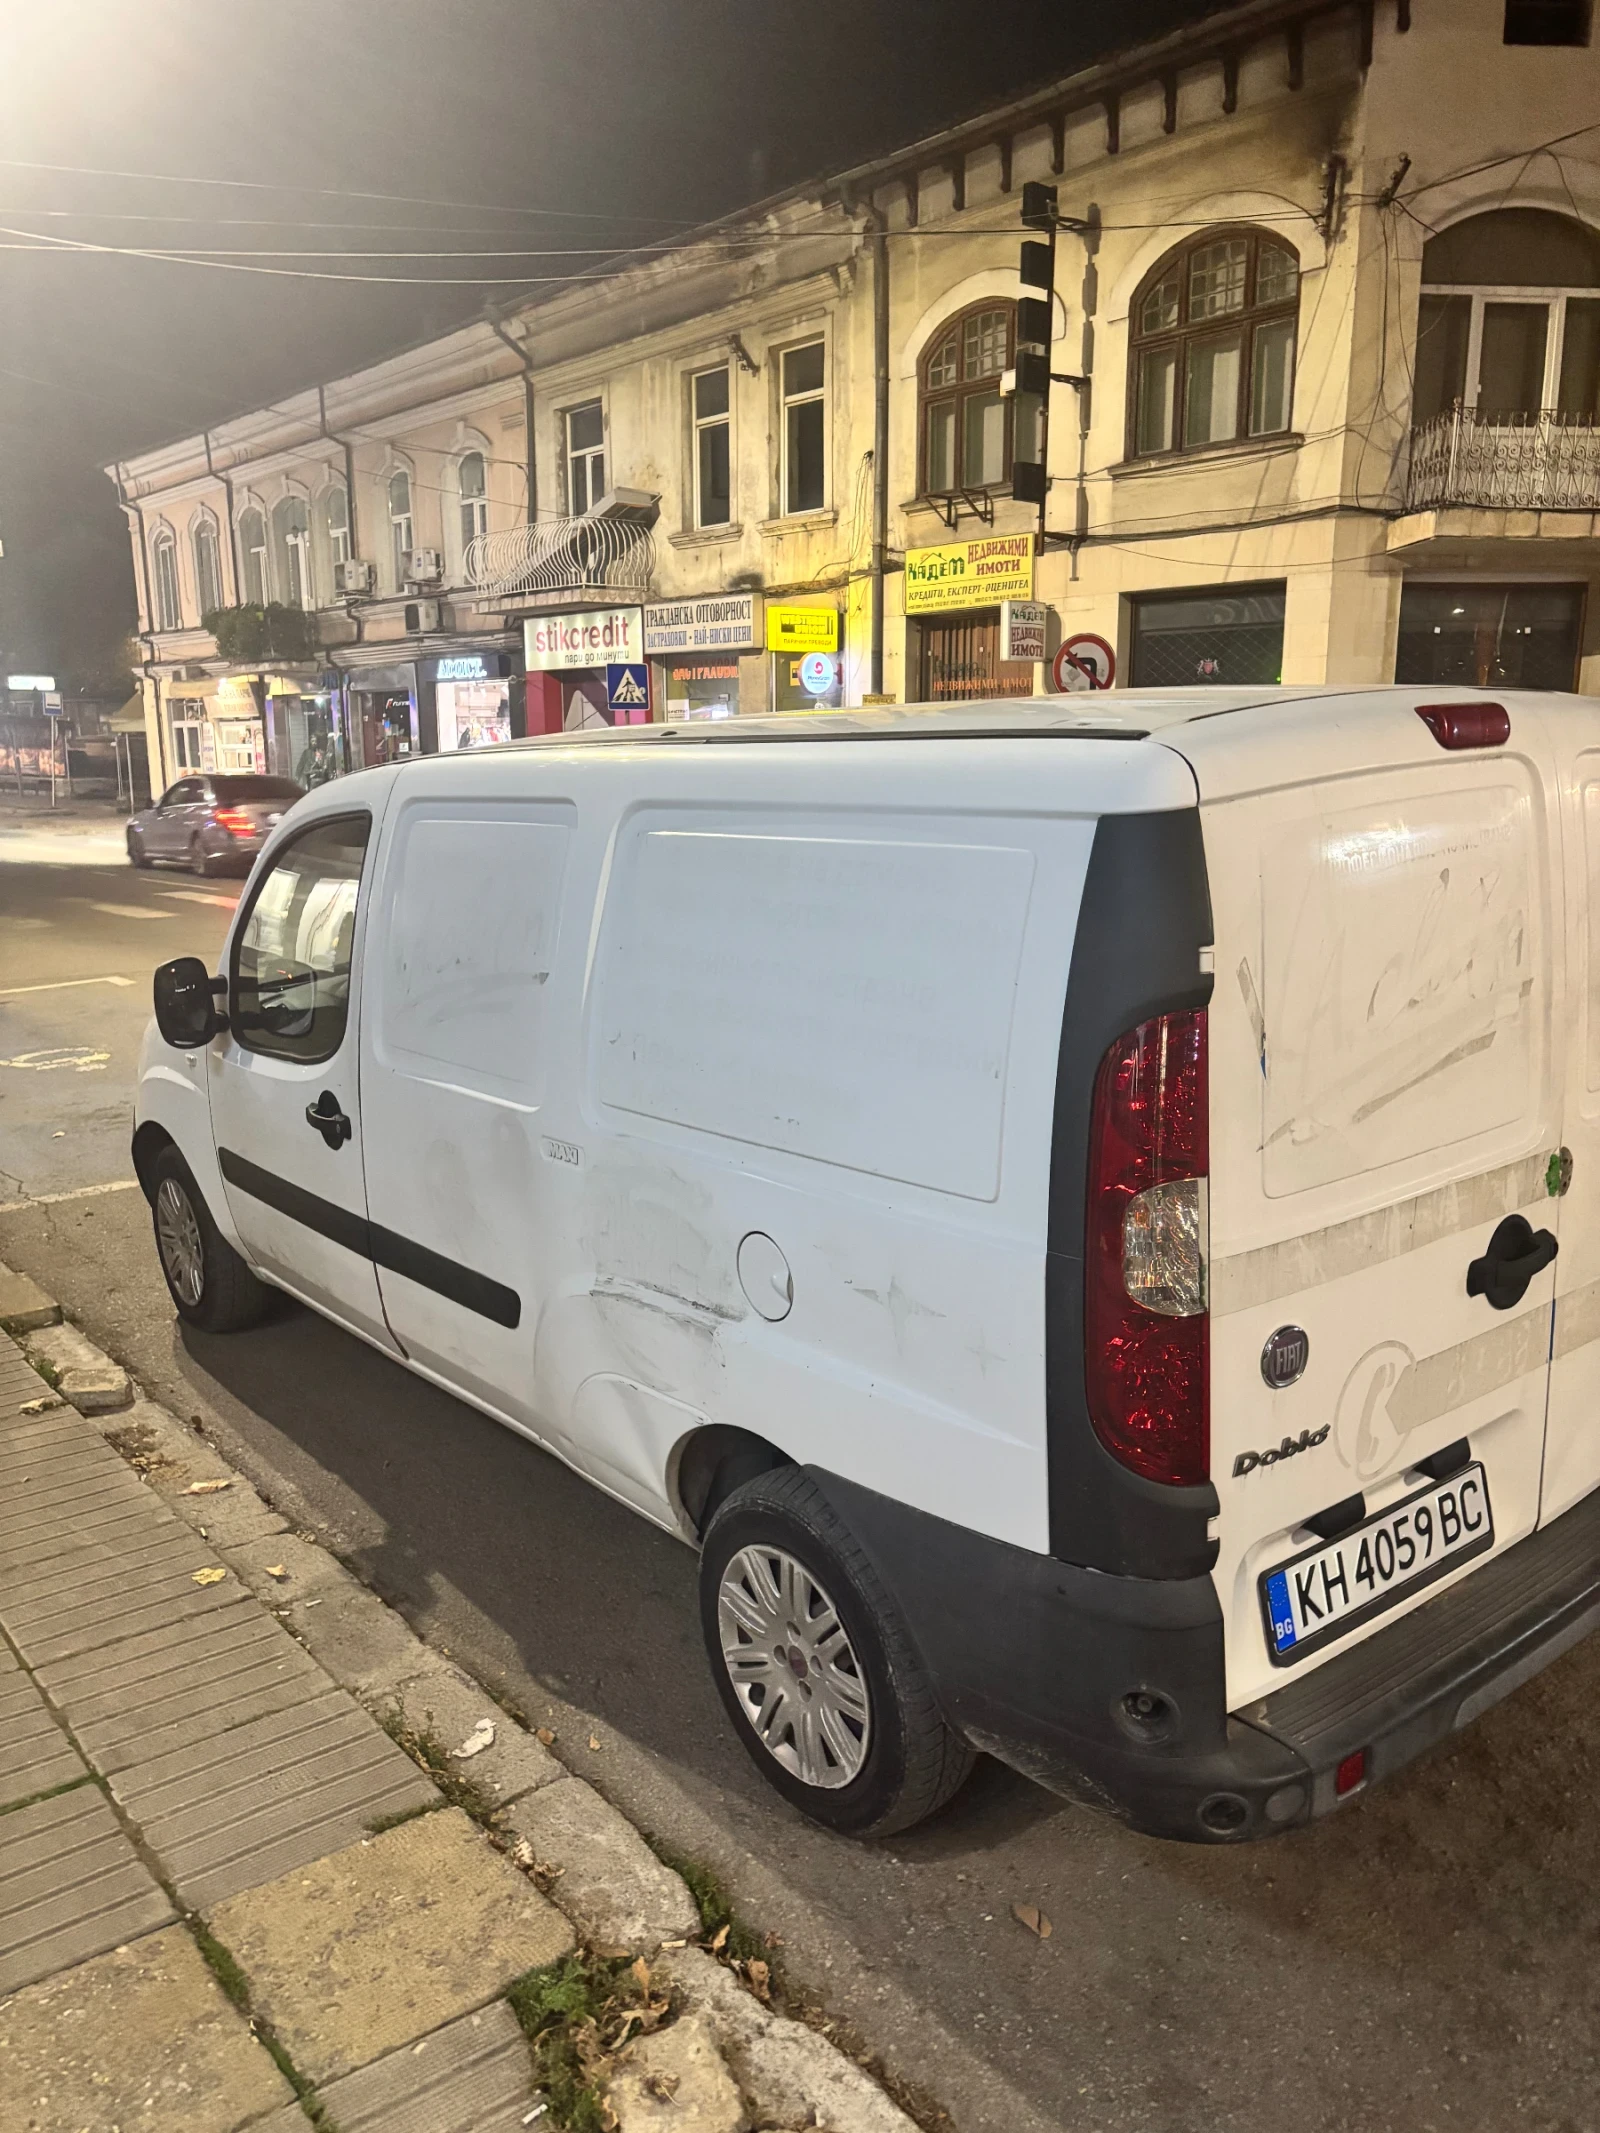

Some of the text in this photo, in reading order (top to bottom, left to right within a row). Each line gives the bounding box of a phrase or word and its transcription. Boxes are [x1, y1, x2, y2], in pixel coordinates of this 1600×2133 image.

[967, 537, 1029, 565] НЕДВИЖИМИ
[976, 559, 1021, 576] ИМОТИ
[646, 600, 752, 628] ГРАЖДАНСКА ОТГОВОРНОСТ
[536, 615, 629, 652] stikcredit
[647, 631, 687, 648] ЗАСТРАХОВКИ
[733, 626, 752, 643] ЦЕНИ
[564, 653, 583, 665] пари
[1011, 643, 1044, 657] ИМОТИ
[933, 677, 1033, 692] НЕДВИЖИМИ ИМОТ
[1275, 1340, 1302, 1375] FIAT
[1294, 1479, 1482, 1628] KH 4059 BC
[1275, 1620, 1293, 1641] BG
